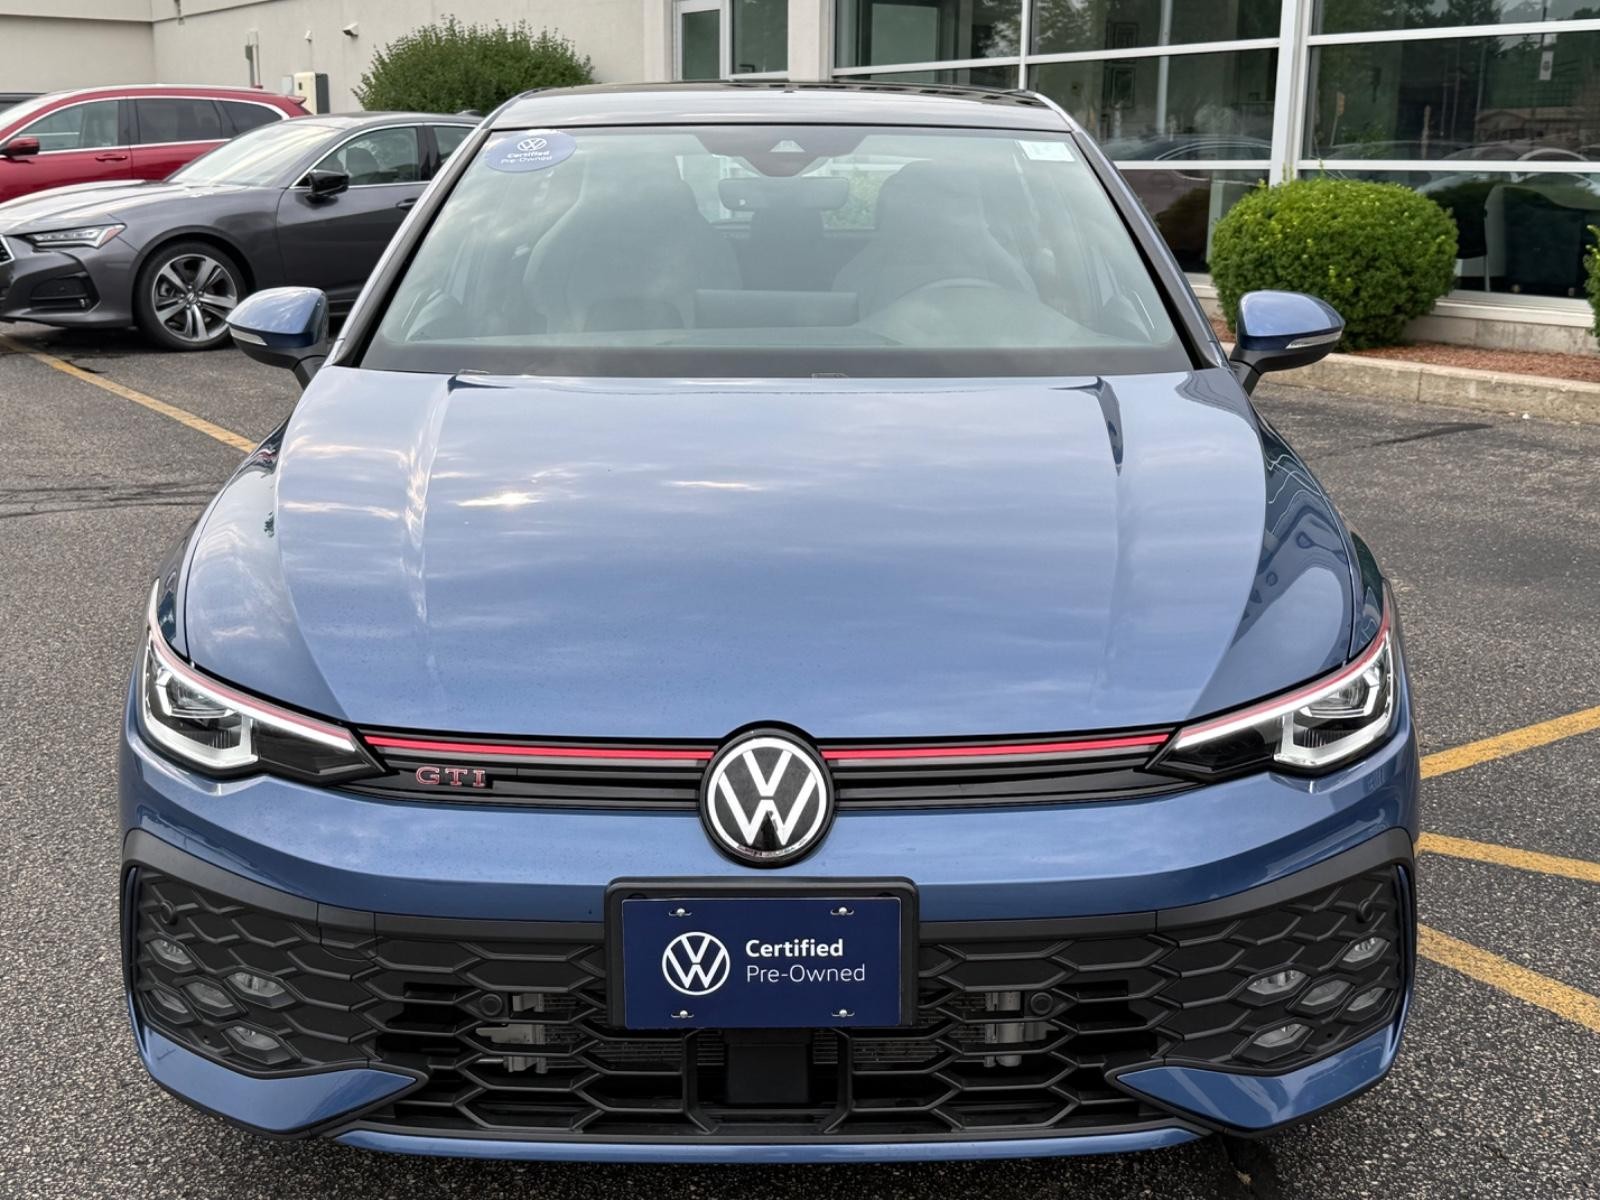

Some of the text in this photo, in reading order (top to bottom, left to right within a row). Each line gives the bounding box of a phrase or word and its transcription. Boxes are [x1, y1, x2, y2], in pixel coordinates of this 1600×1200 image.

[415, 766, 486, 788] GTI
[714, 745, 820, 848] VW
[745, 938, 844, 958] Certified
[745, 963, 866, 983] Pre-Owned
